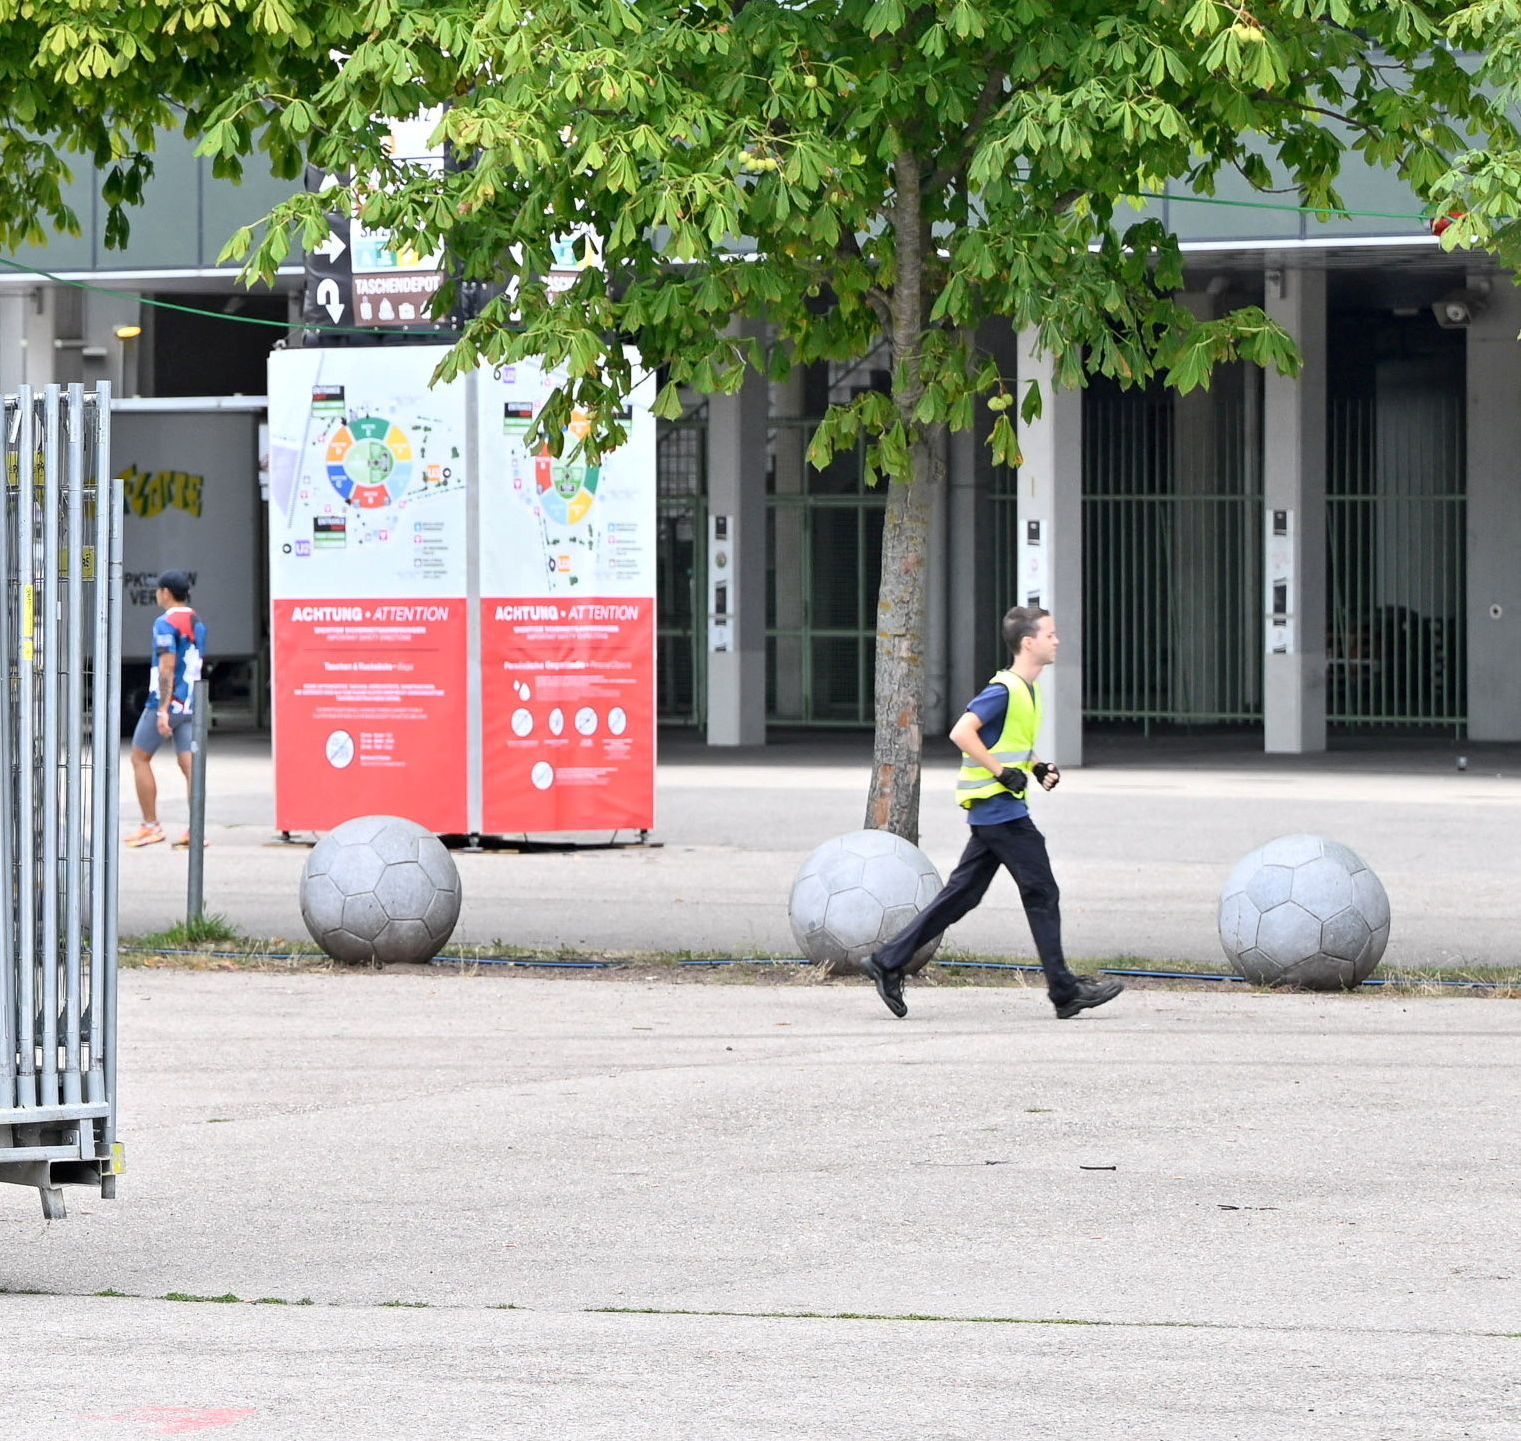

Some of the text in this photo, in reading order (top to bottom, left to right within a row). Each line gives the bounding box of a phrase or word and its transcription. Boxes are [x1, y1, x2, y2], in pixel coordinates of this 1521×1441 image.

[355, 275, 441, 295] TASCHENDEPOT
[291, 606, 449, 622] ACHTUNG ATTENTION
[495, 604, 640, 621] ACHTUNG ATTENTION
